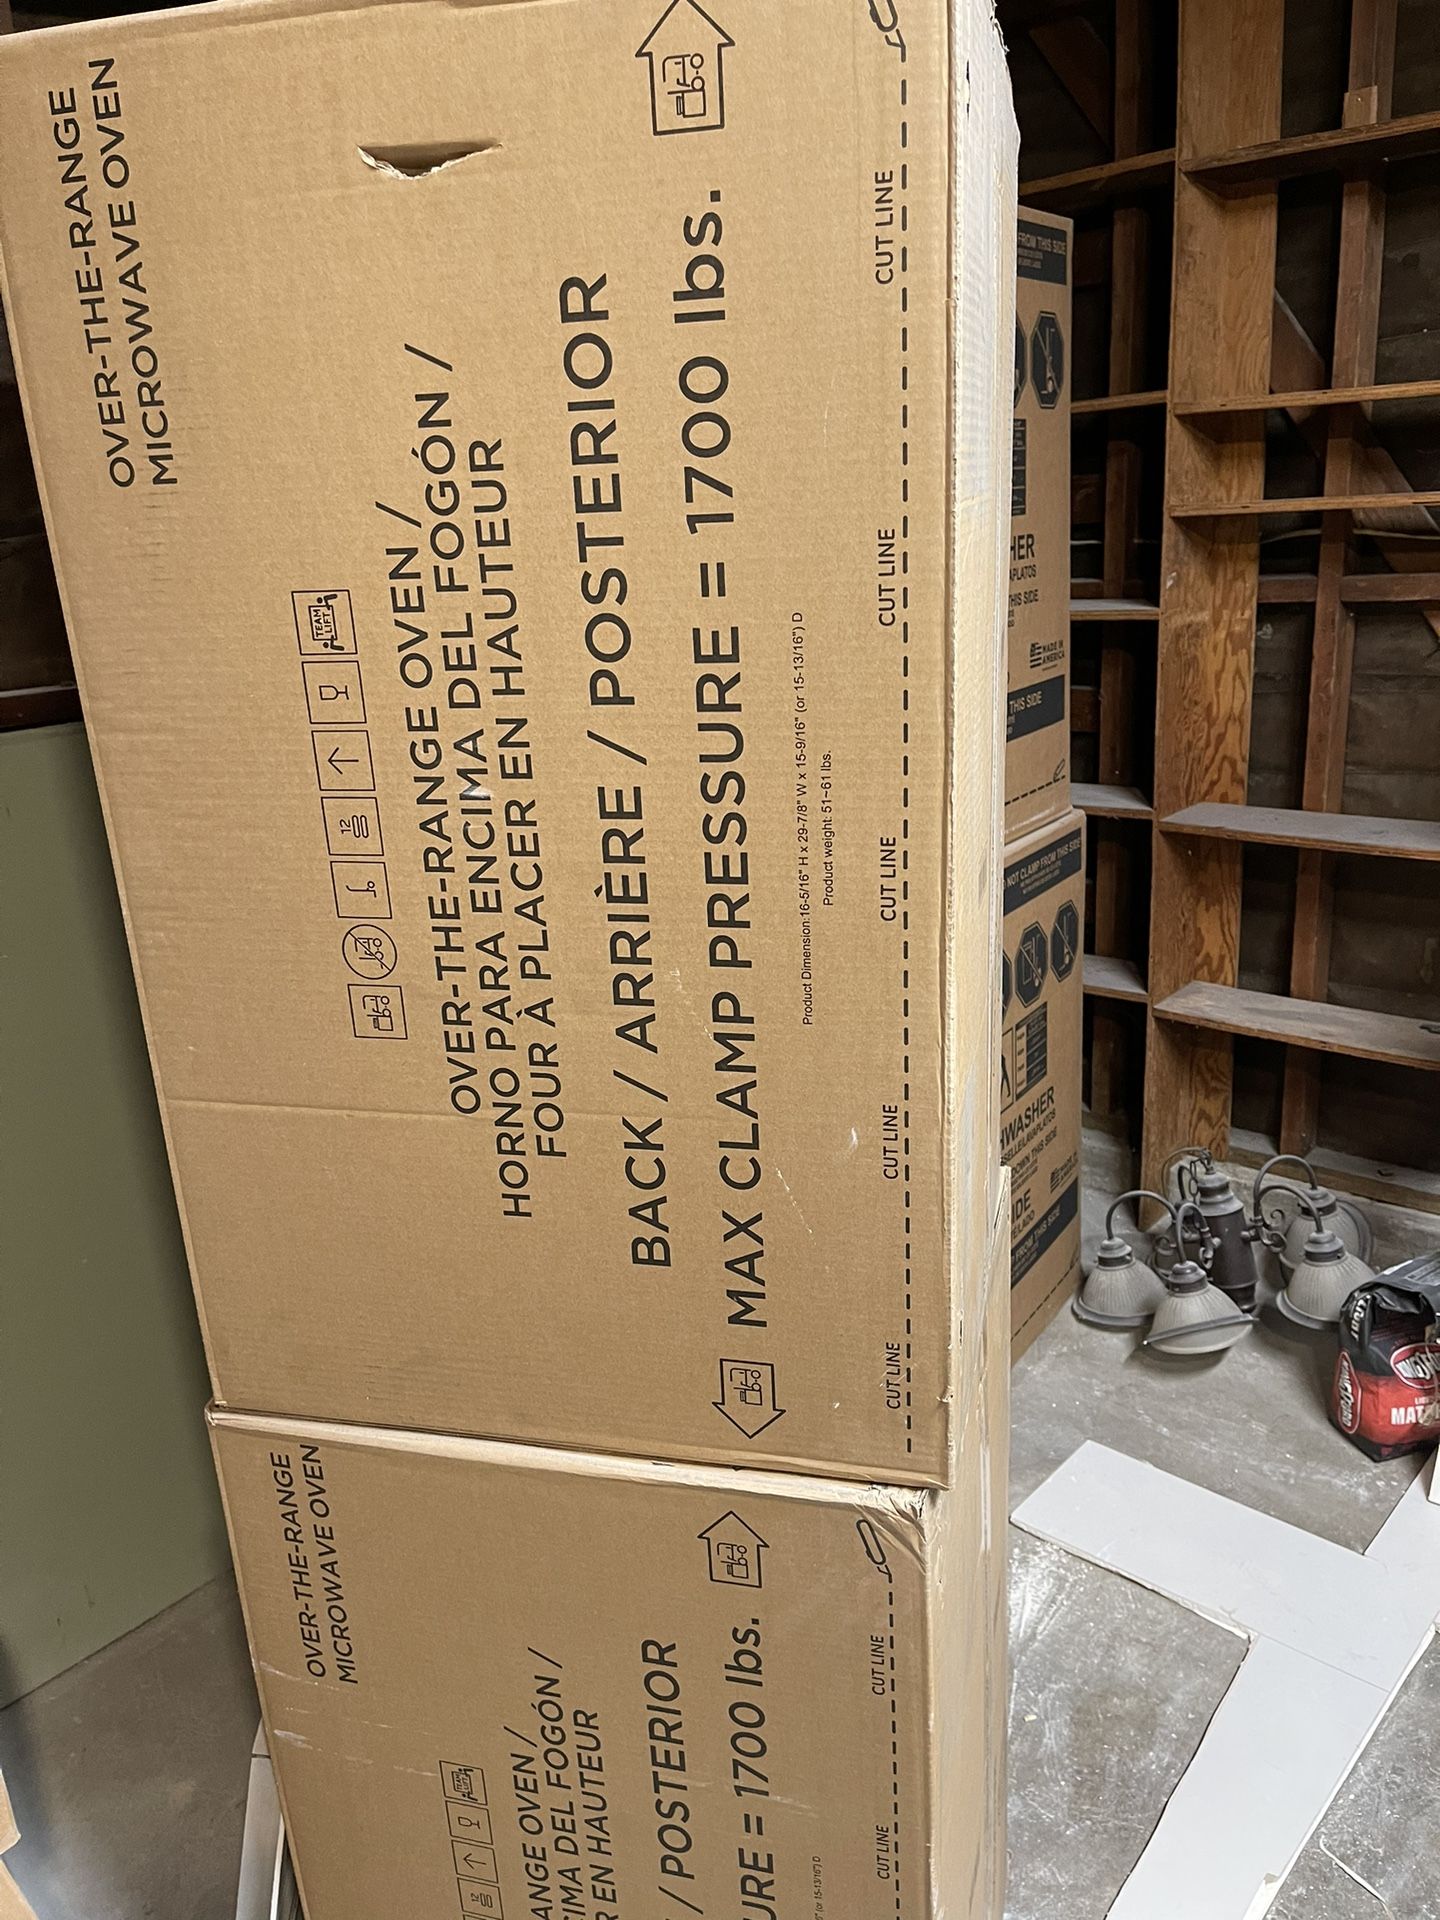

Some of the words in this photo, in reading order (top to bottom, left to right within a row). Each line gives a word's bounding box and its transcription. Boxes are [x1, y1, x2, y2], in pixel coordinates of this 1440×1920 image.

[88, 57, 130, 189] OVEN
[875, 169, 893, 226] LINE
[673, 189, 726, 324] lbs.
[875, 235, 893, 285] CUT
[48, 87, 135, 487] OVER-THE-RANGE
[108, 201, 178, 485] MICROWAVE
[404, 343, 453, 372] /
[678, 355, 735, 535] 1700
[411, 392, 469, 593] FOGÓN
[559, 273, 635, 706] POSTERIOR
[375, 501, 422, 528] /
[468, 438, 525, 696] HAUTEUR
[878, 528, 895, 577] LINE
[700, 562, 726, 597] =
[313, 609, 323, 637] TEAM
[323, 612, 333, 634] LIFT
[385, 547, 433, 689] OVEN
[792, 612, 803, 622] D
[878, 583, 896, 627] CUT
[441, 612, 481, 709] DEL
[792, 626, 806, 691] 15-13/16")
[795, 696, 807, 713] (or
[1010, 697, 1025, 714] THIS
[1026, 690, 1042, 708] SIDE
[495, 717, 533, 779] EN
[586, 729, 648, 766] /
[795, 717, 806, 768] 15-9/16"
[820, 750, 832, 771] lbs.
[692, 626, 752, 969] PRESSURE
[796, 784, 807, 797] W
[821, 776, 832, 813] 51~61
[340, 819, 351, 834] 12
[453, 728, 502, 913] ENCIMA
[797, 800, 808, 843] 29-7/8"
[822, 817, 835, 858] weight:
[799, 857, 808, 866] H
[880, 837, 897, 878] LINE
[505, 799, 552, 980] PLACER
[823, 861, 833, 906] Product
[880, 884, 897, 922] CUT
[405, 706, 481, 1114] OVER-THE-RANGE
[593, 786, 658, 1053] ARRIÈRE
[475, 930, 517, 1051] PARA
[516, 997, 555, 1028] À
[803, 983, 813, 1025] Product
[528, 1043, 567, 1157] FOUR
[612, 1069, 668, 1102] /
[712, 991, 762, 1190] CLAMP
[488, 1067, 532, 1217] HORNO
[882, 1104, 898, 1142] LINE
[882, 1147, 898, 1180] CUT
[622, 1116, 671, 1267] BACK
[721, 1210, 768, 1328] MAX
[886, 1342, 900, 1375] LINE
[886, 1379, 900, 1409] CUT
[300, 1444, 330, 1518] OVEN
[270, 1452, 326, 1677] OVER-THE-RANGE
[314, 1524, 358, 1684] MICROWAVE
[528, 1646, 563, 1670] /
[725, 1618, 764, 1687] lbs.
[870, 1635, 884, 1660] LINE
[872, 1668, 885, 1696] CUT
[504, 1726, 538, 1748] /
[530, 1675, 572, 1790] FOGÓN
[728, 1701, 770, 1798] 1700
[456, 1772, 464, 1791] TEAM
[573, 1709, 613, 1856] HAUTEUR
[641, 1639, 695, 1880] POSTERIOR
[510, 1752, 544, 1836] OVEN
[550, 1800, 580, 1856] DEL
[744, 1813, 764, 1836] =
[876, 1825, 890, 1851] LINE
[589, 1864, 617, 1904] EN
[877, 1858, 890, 1880] CUT
[658, 1886, 704, 1915] /
